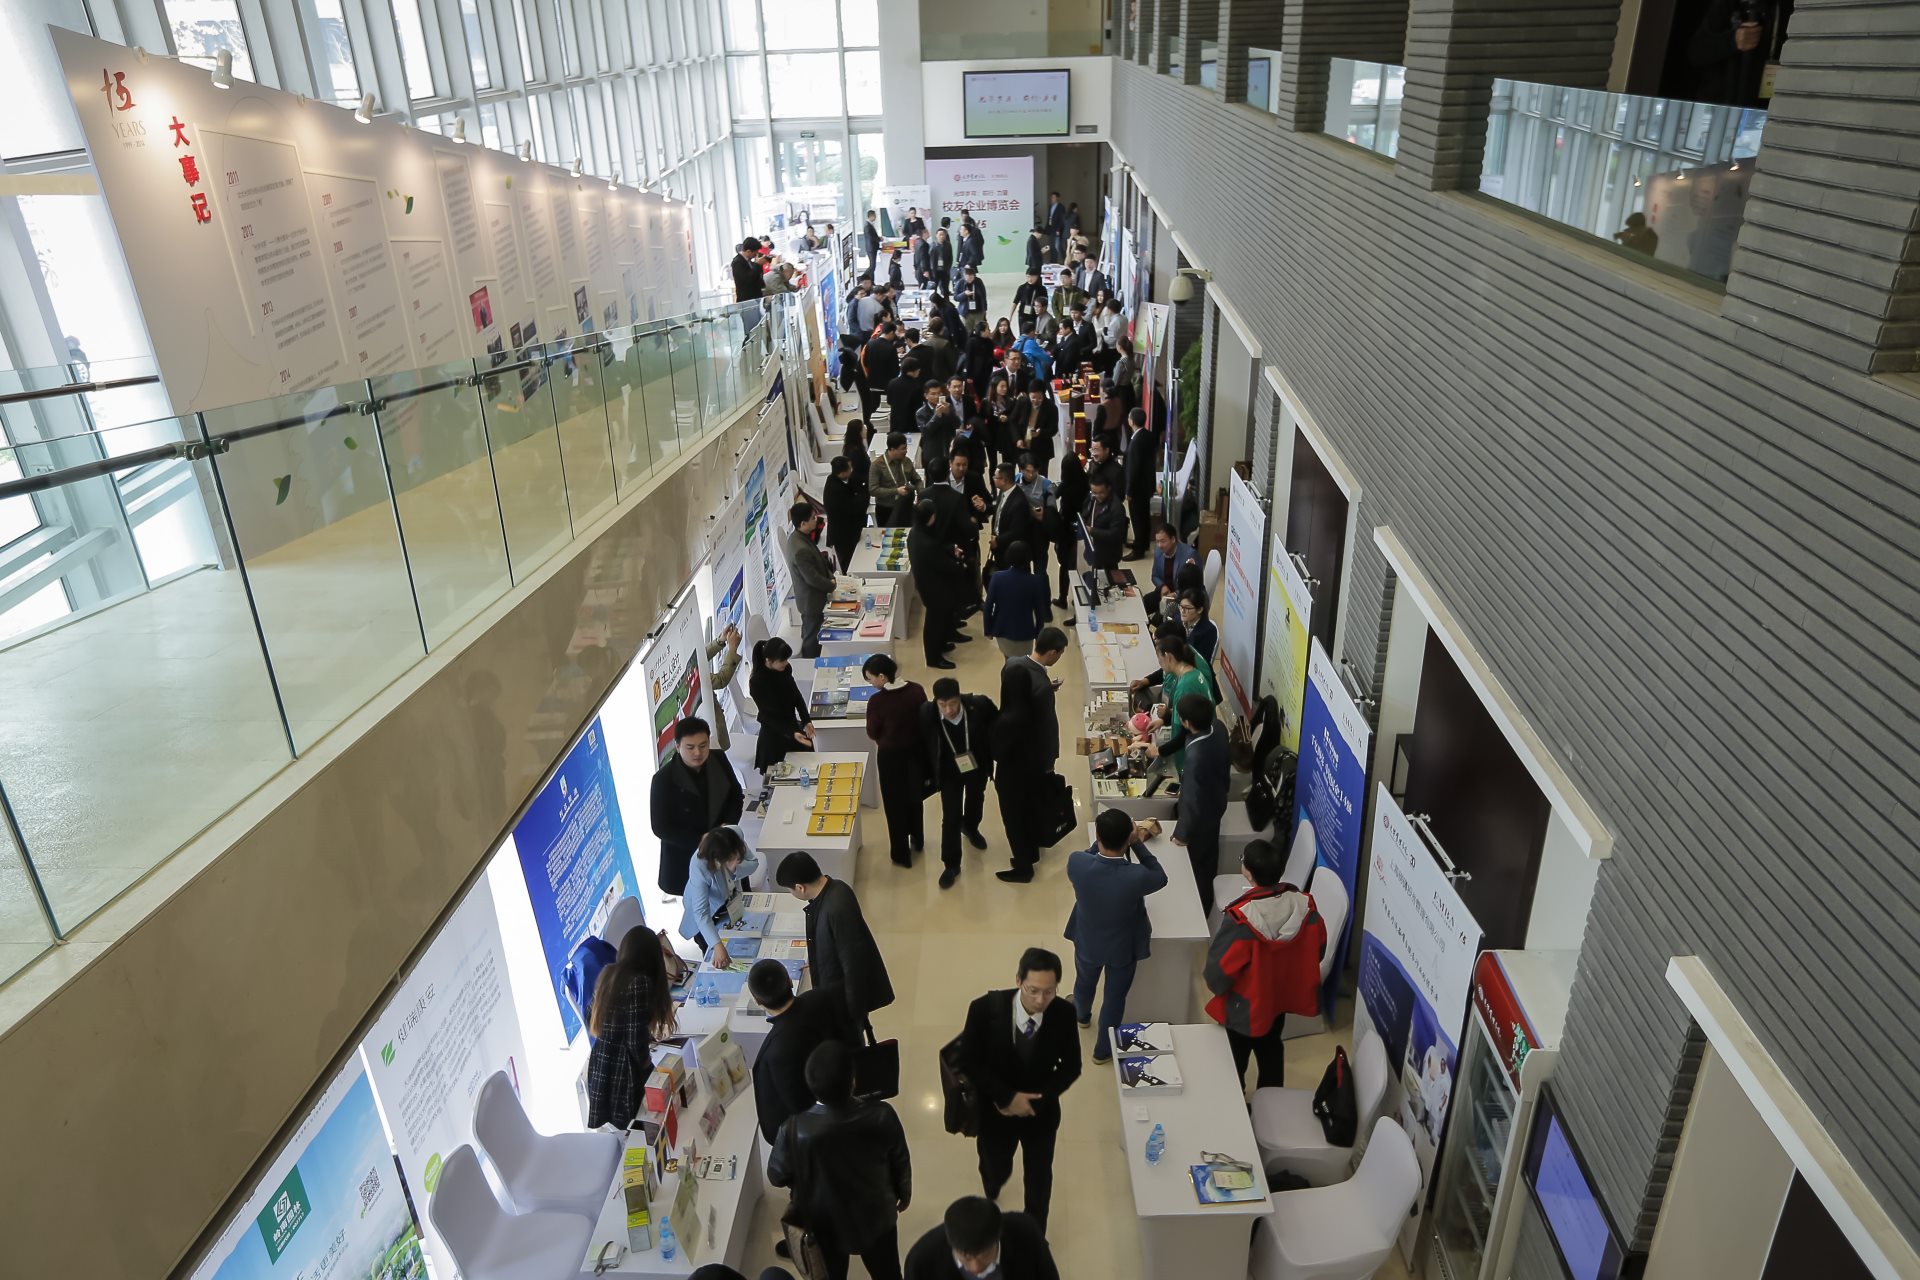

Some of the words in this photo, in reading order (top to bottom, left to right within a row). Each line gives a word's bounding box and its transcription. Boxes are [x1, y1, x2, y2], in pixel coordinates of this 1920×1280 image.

[112, 121, 146, 138] YEARS
[168, 116, 212, 224] 大事记
[227, 171, 240, 185] 2011
[943, 199, 1020, 212] 校友企业博览会
[241, 224, 254, 239] 2012
[262, 301, 273, 316] 2013
[280, 368, 291, 383] 2014
